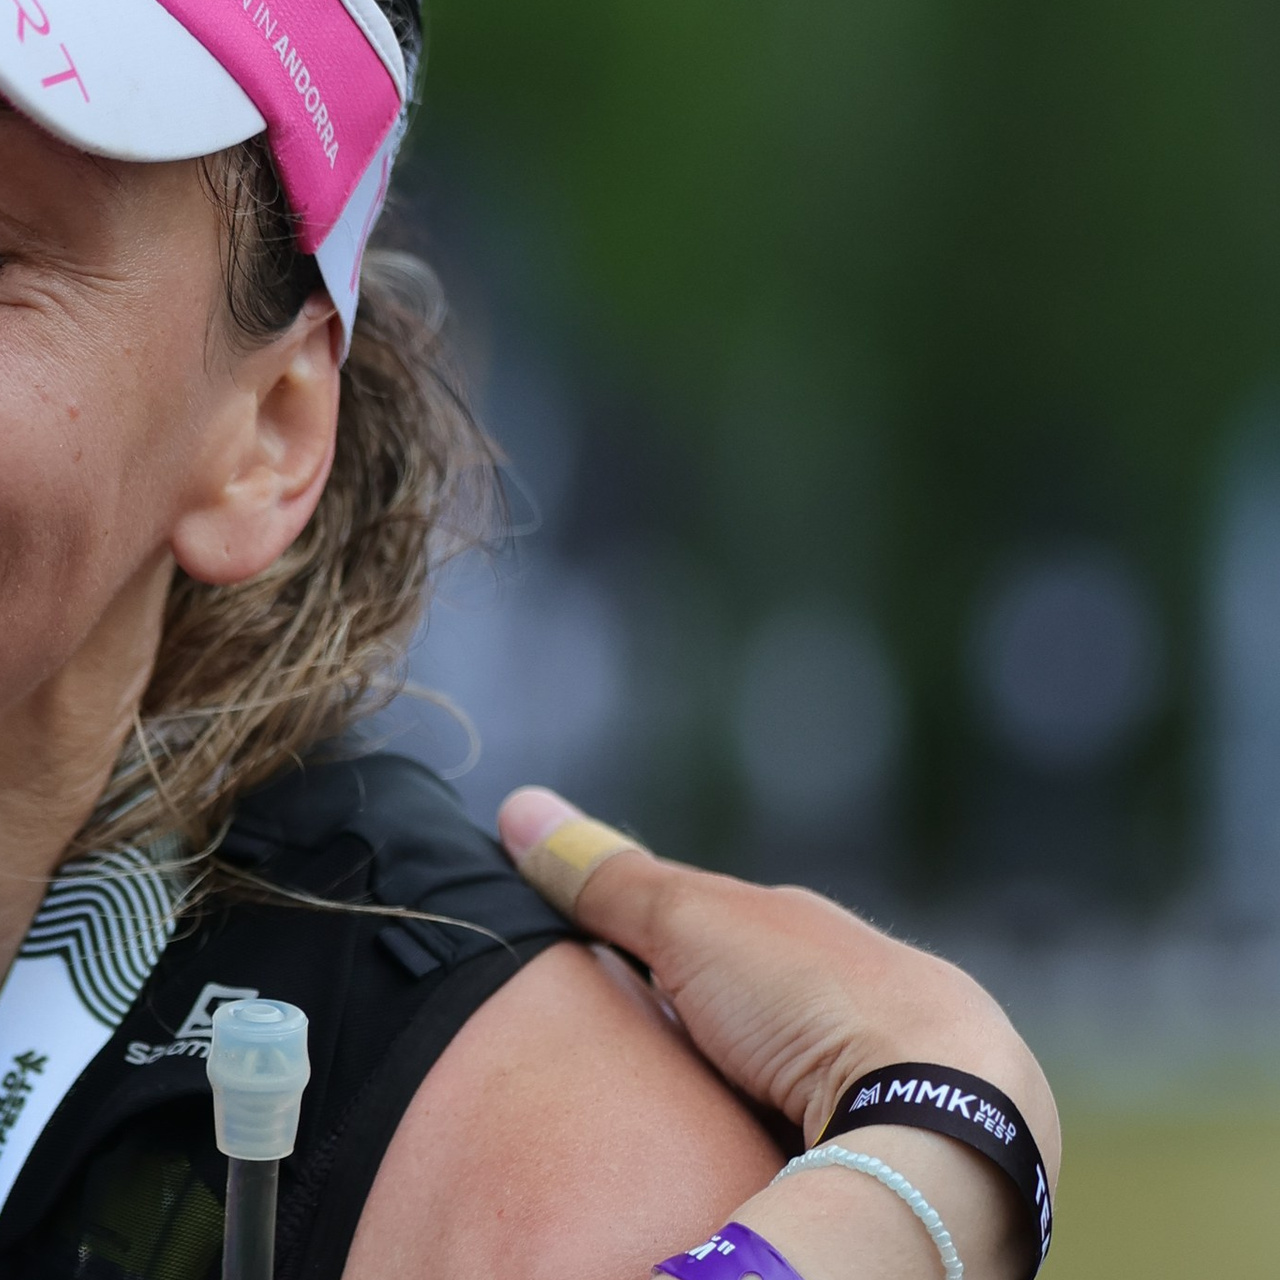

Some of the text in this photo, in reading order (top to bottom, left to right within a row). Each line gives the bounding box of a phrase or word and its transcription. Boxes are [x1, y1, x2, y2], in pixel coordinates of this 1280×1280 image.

[252, 1, 278, 39] IN
[272, 35, 340, 170] ANDORRA
[884, 1079, 977, 1119] MMK
[978, 1099, 1017, 1137] WILD
[973, 1111, 1013, 1145] FEST
